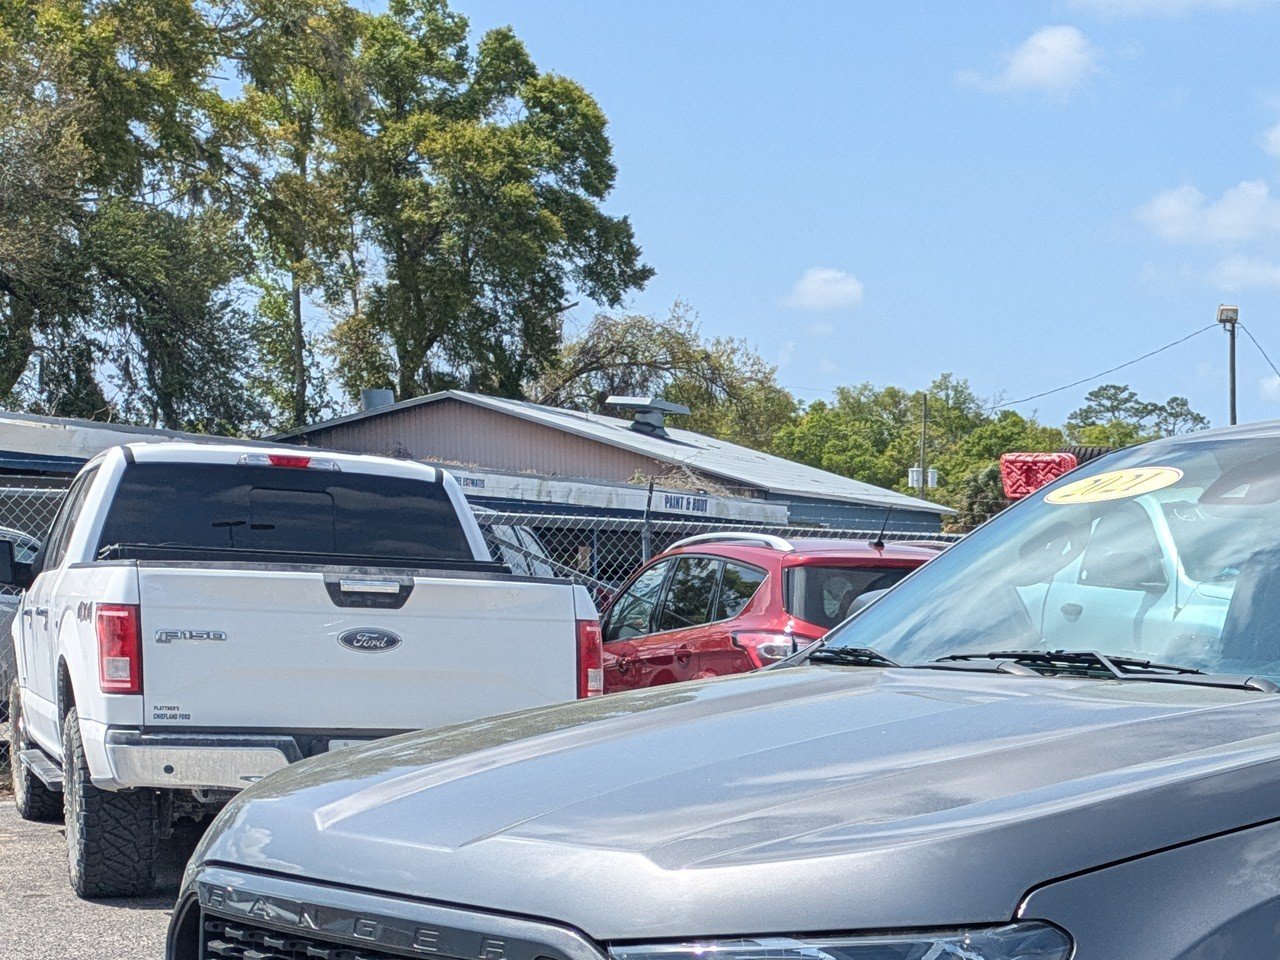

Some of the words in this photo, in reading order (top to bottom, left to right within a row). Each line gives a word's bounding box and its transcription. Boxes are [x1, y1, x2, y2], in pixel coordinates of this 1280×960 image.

[1057, 471, 1165, 499] 2021
[664, 494, 685, 510] PAINT
[353, 632, 388, 647] Ford
[179, 713, 191, 721] FORD
